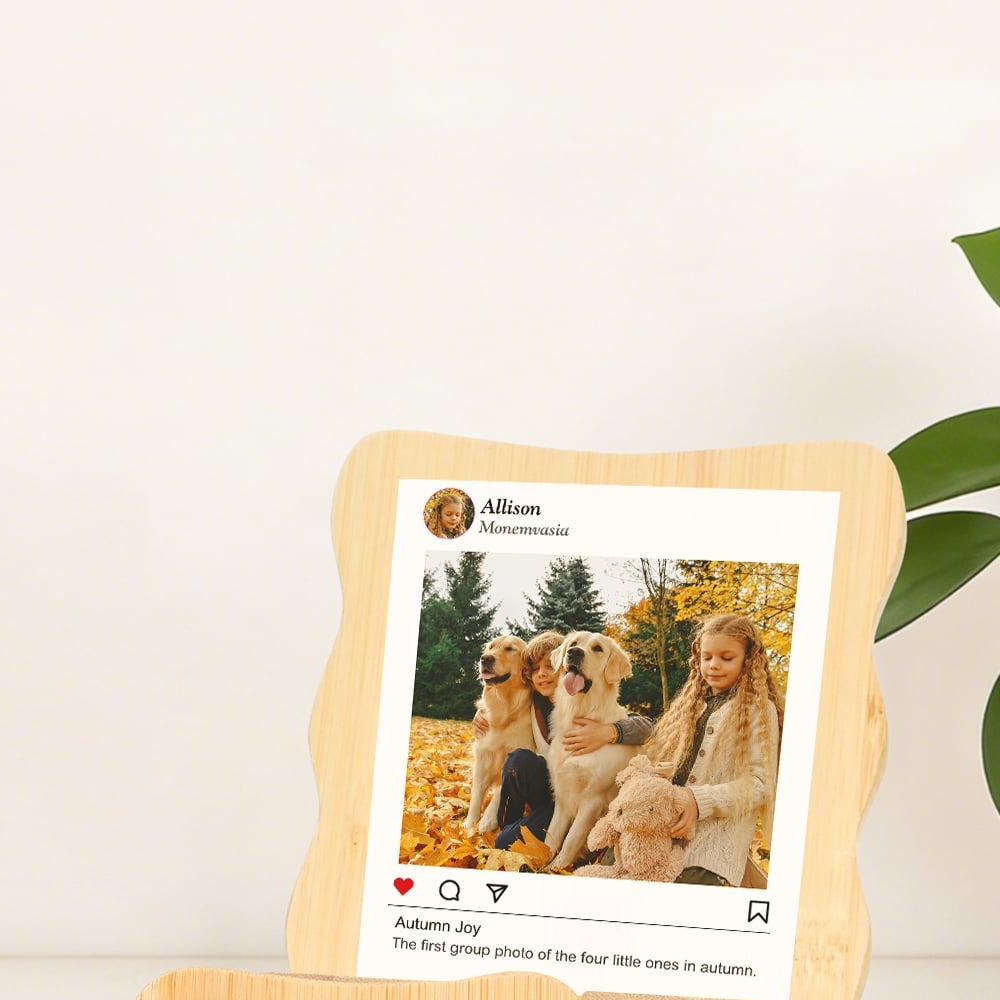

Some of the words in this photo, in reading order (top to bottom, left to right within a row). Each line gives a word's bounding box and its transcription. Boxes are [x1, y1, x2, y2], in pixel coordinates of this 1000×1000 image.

[479, 498, 541, 516] Allison
[478, 519, 570, 537] Monemvasia
[394, 915, 451, 933] Autumn
[455, 920, 482, 938] Joy
[392, 936, 417, 950] The
[421, 939, 447, 953] first
[450, 943, 491, 959] group
[494, 945, 534, 960] photo
[537, 948, 553, 961] of
[555, 949, 577, 963] the
[580, 951, 609, 965] four
[612, 954, 641, 968] little
[645, 959, 679, 971] ones
[683, 959, 696, 972] in
[700, 962, 757, 977] autumn.
